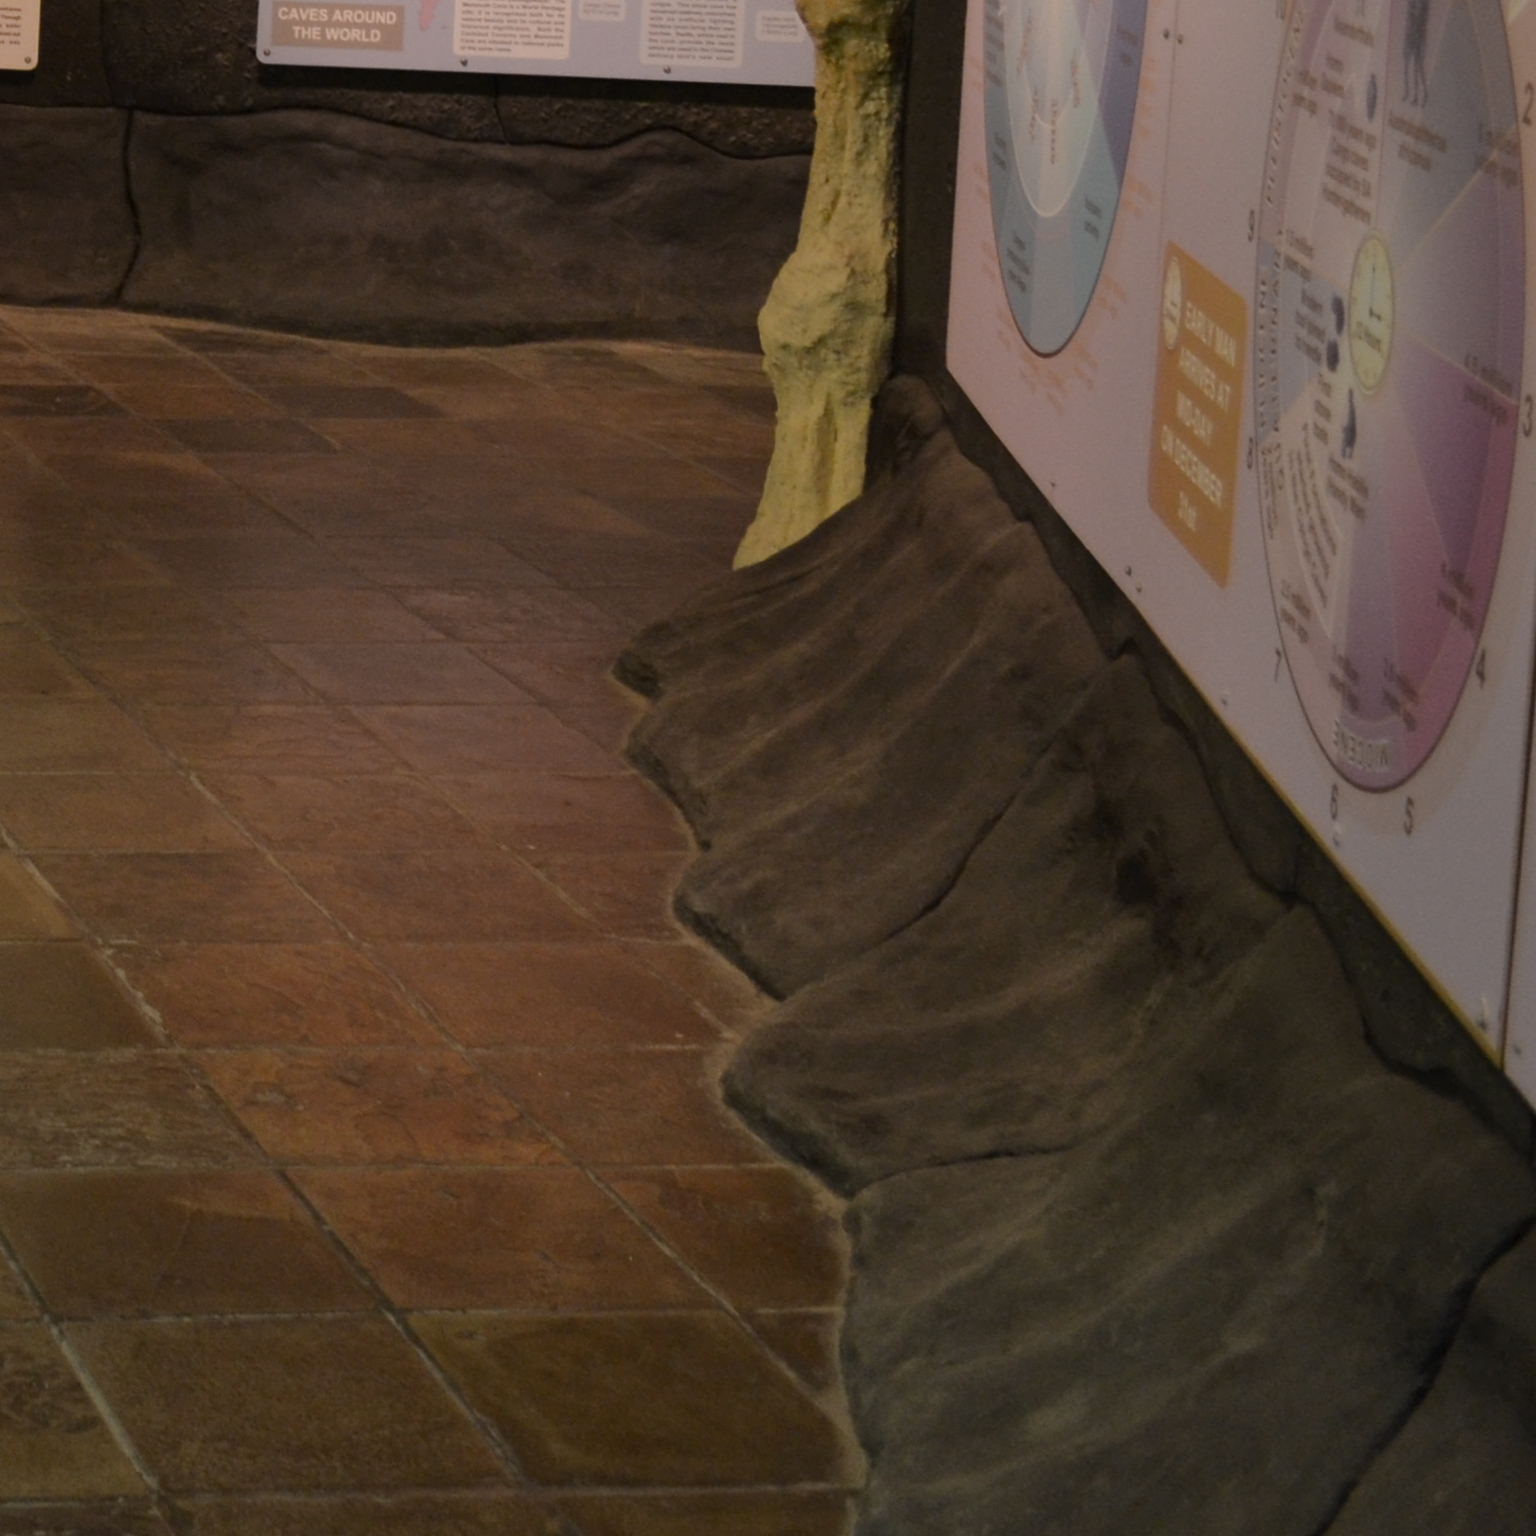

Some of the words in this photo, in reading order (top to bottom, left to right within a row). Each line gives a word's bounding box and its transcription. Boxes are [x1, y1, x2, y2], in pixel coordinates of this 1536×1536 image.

[278, 7, 328, 22] CAVES
[332, 10, 397, 25] AROUND
[292, 26, 321, 40] THE
[325, 28, 381, 42] WORLD
